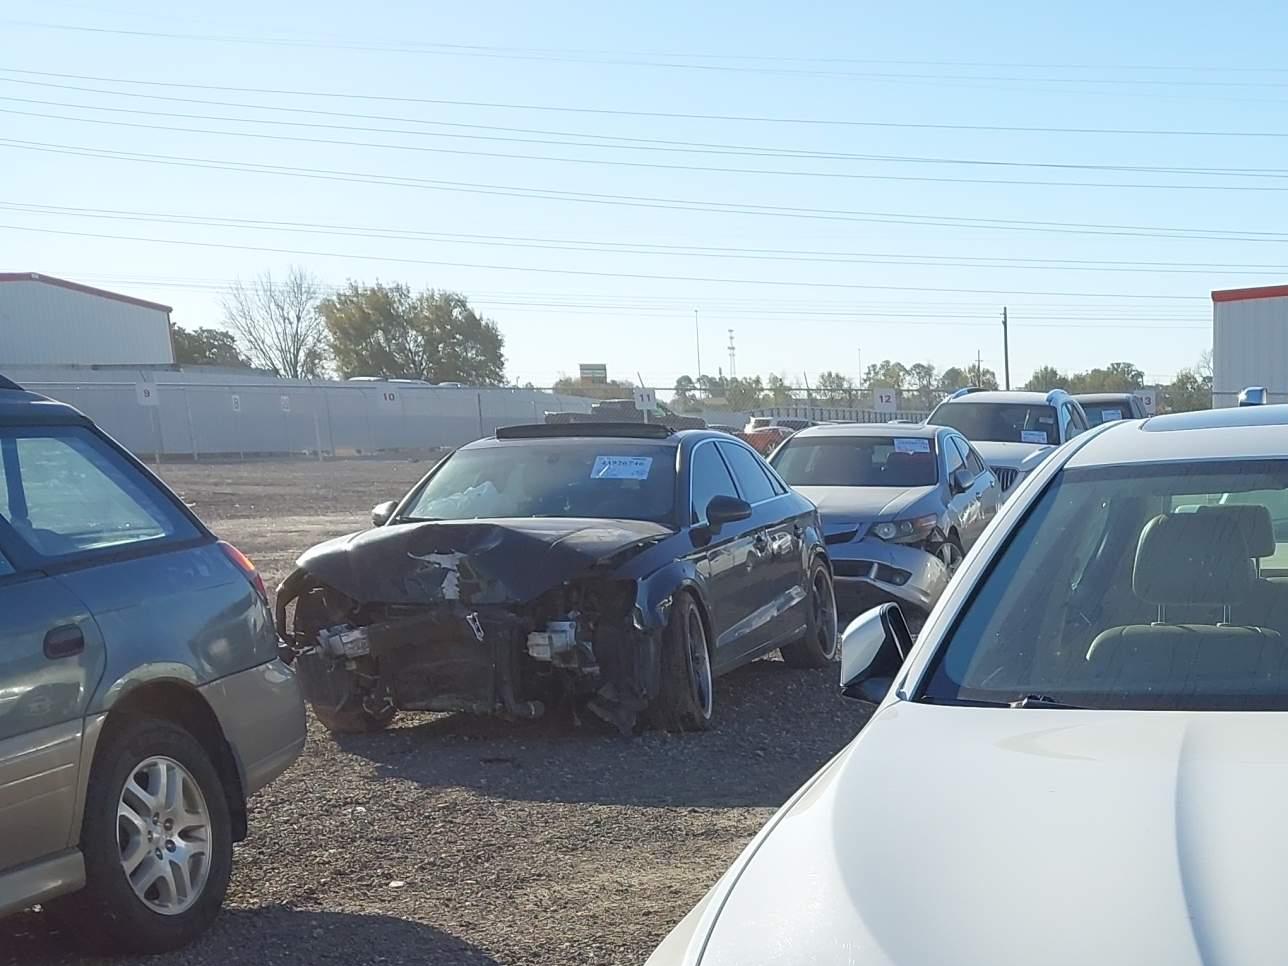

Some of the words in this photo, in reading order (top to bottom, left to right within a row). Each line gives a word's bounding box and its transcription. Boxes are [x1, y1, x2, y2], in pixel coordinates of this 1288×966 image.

[143, 388, 151, 398] 9
[383, 392, 395, 401] 10
[640, 393, 651, 402] 11
[880, 394, 892, 404] 12
